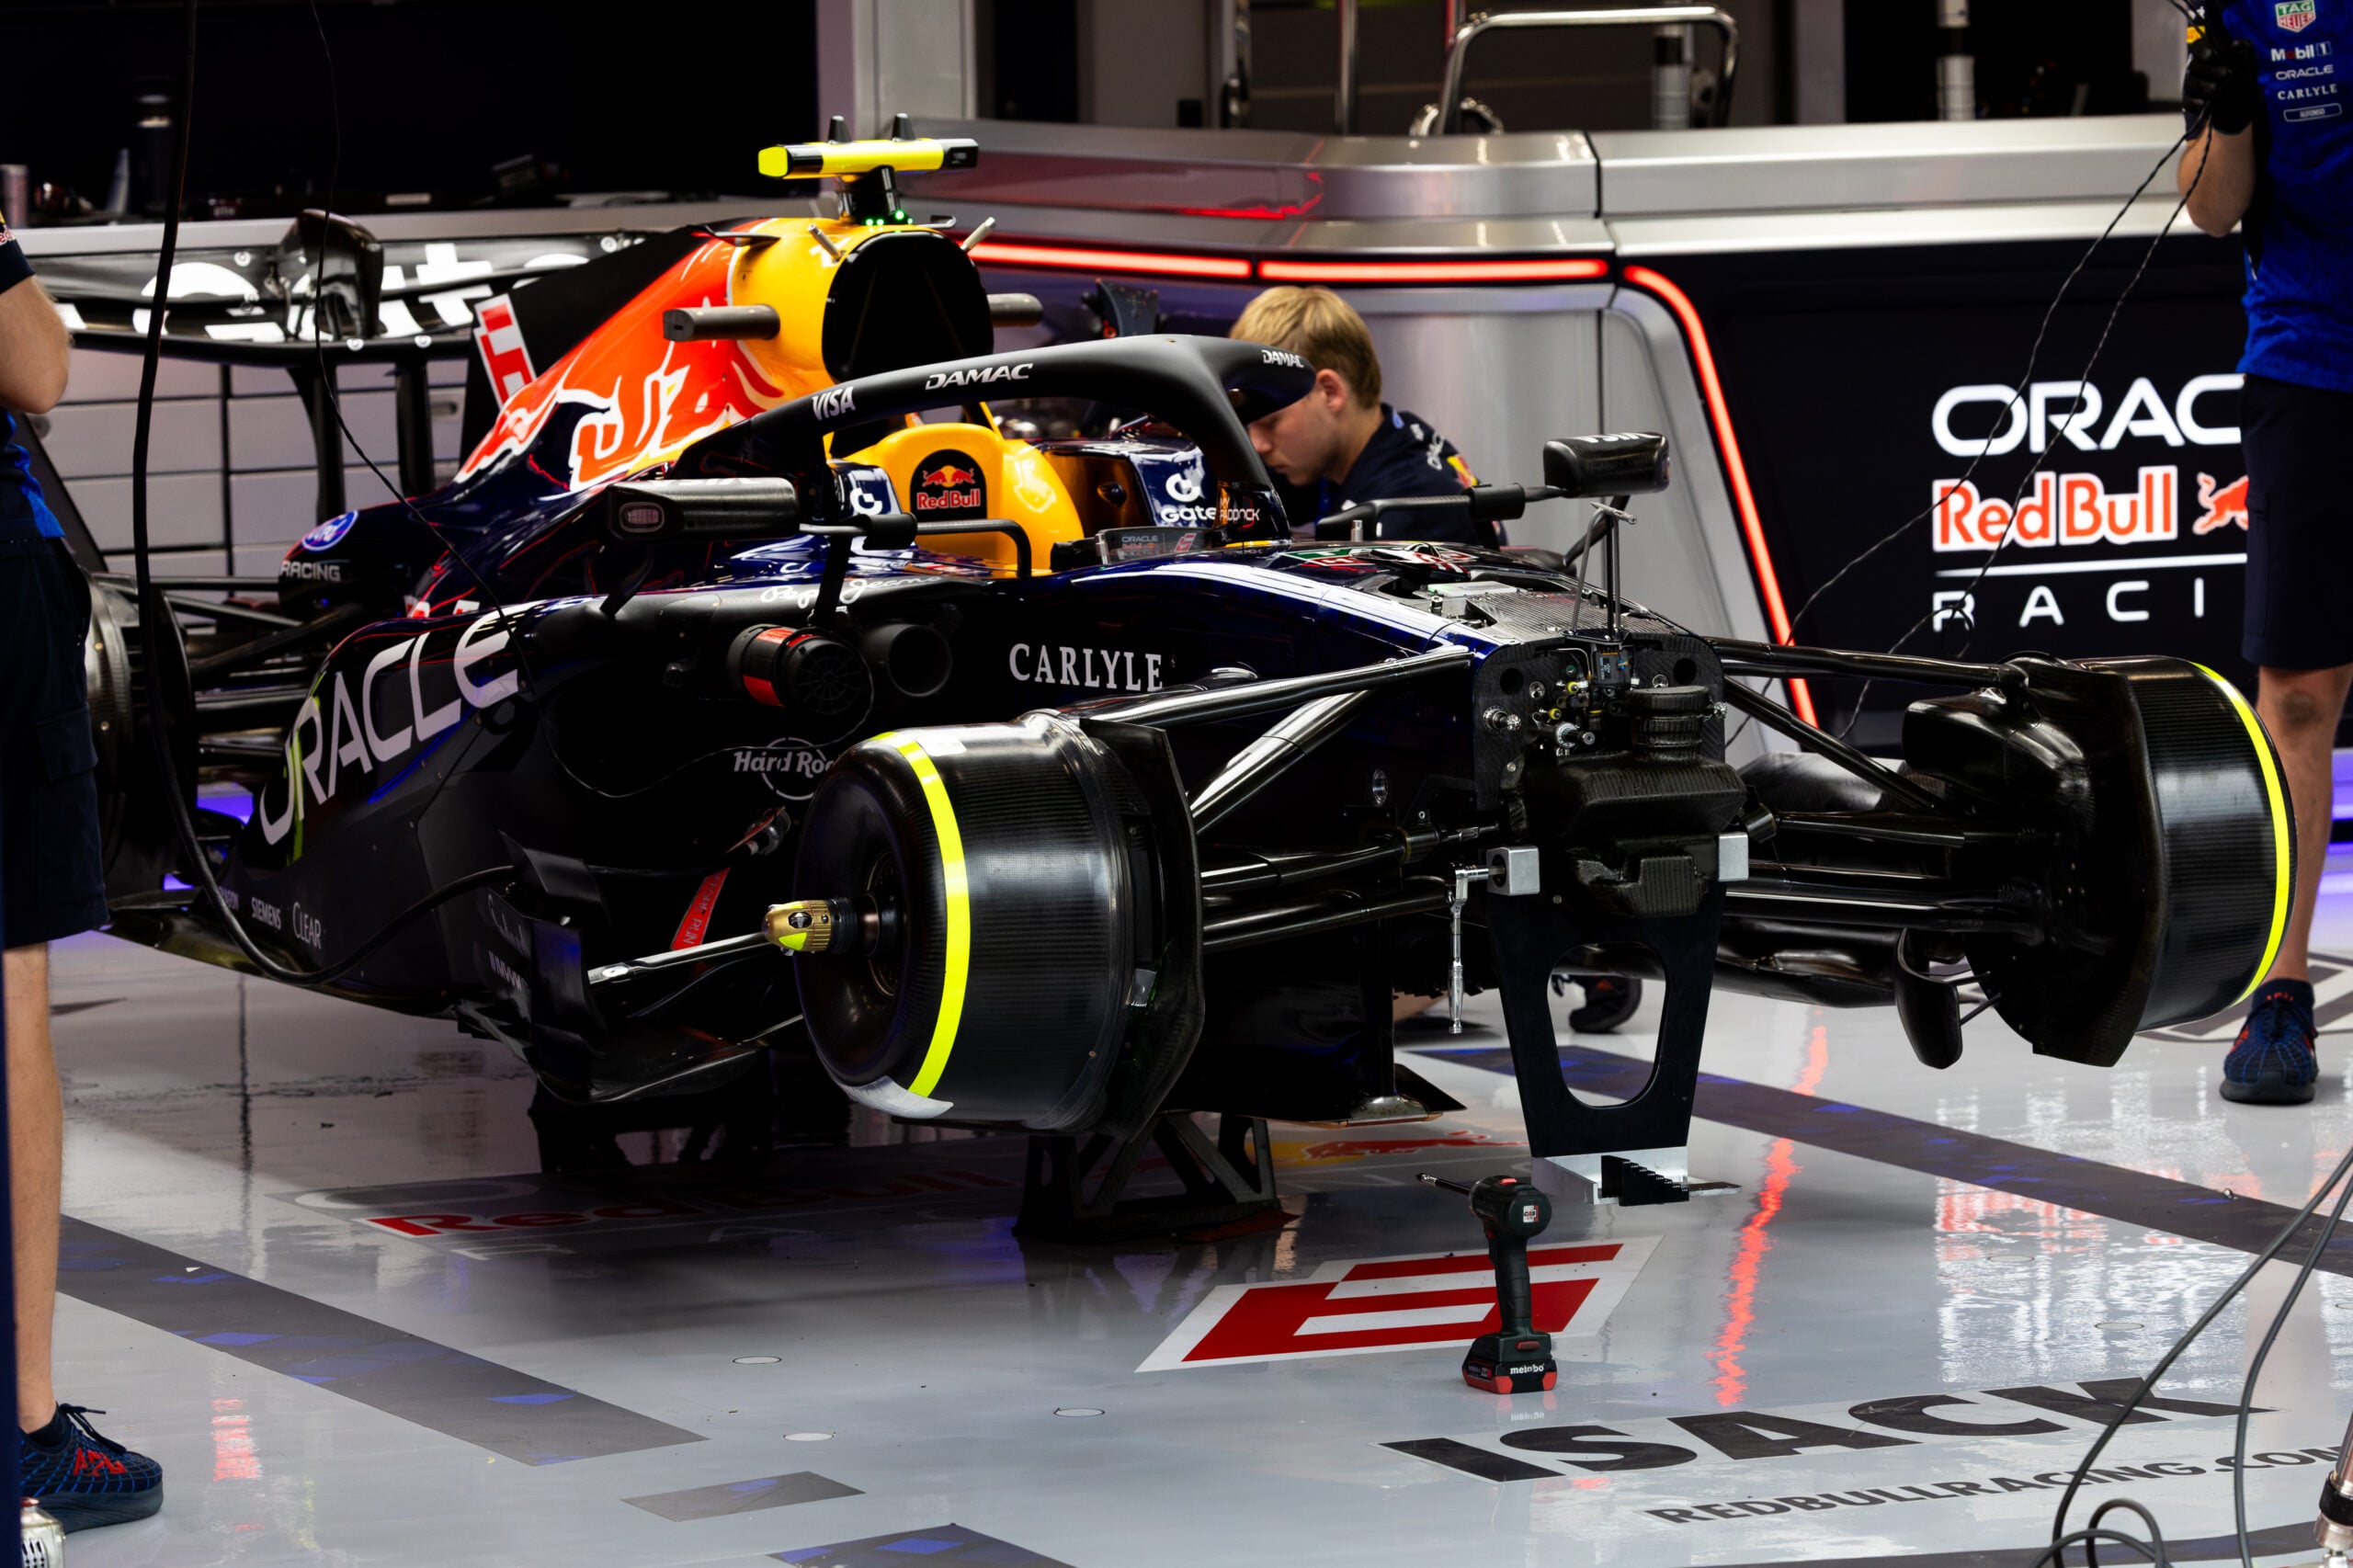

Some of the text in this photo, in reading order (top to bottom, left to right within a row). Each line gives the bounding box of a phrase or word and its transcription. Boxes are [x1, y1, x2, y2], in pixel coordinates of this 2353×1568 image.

[2278, 1, 2313, 13] TAG
[2279, 12, 2314, 28] HEUER
[2270, 43, 2314, 62] Mobil
[2275, 64, 2334, 80] ORACLE
[2277, 84, 2338, 100] CARLYLE
[1260, 349, 1304, 368] DAMAC
[925, 363, 1034, 391] DAMAC
[812, 386, 856, 421] VISA
[1932, 373, 2246, 458] ORAC
[1160, 505, 1216, 523] Gate
[1121, 535, 1158, 543] ORACLE
[281, 560, 341, 583] RACING
[760, 585, 819, 608] Pep
[1933, 577, 2205, 632] RACI
[1009, 643, 1163, 692] CARLYLE
[733, 751, 835, 778] Hard Ro
[251, 897, 281, 930] SIEMENS
[1509, 1363, 1545, 1375] metabo
[1379, 1376, 2279, 1483] ISACK
